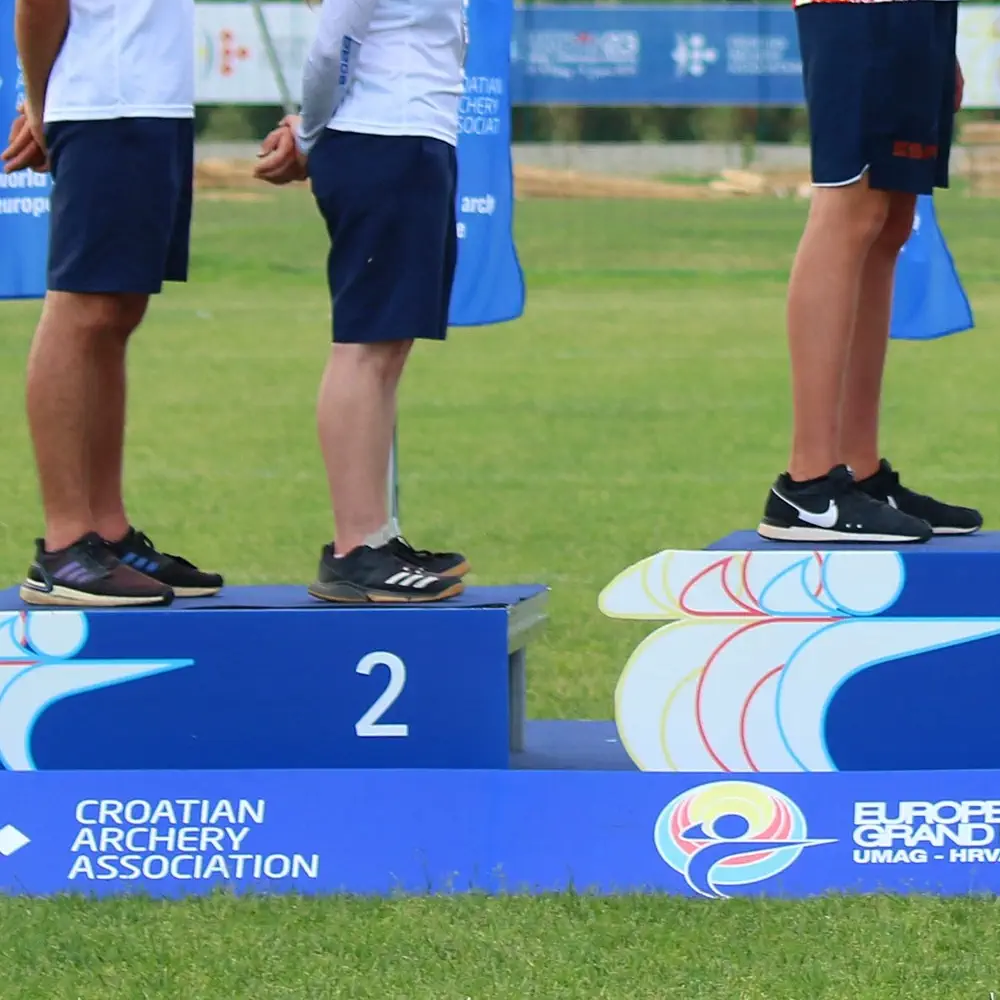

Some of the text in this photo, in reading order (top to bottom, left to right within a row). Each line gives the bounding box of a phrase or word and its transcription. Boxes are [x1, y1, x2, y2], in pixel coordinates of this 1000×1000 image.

[355, 651, 408, 737] 2
[75, 799, 265, 825] CROATIAN
[71, 827, 250, 851] ARCHERY
[853, 823, 995, 847] GRAND
[67, 854, 319, 880] ASSOCIATION
[852, 849, 928, 864] UMAG
